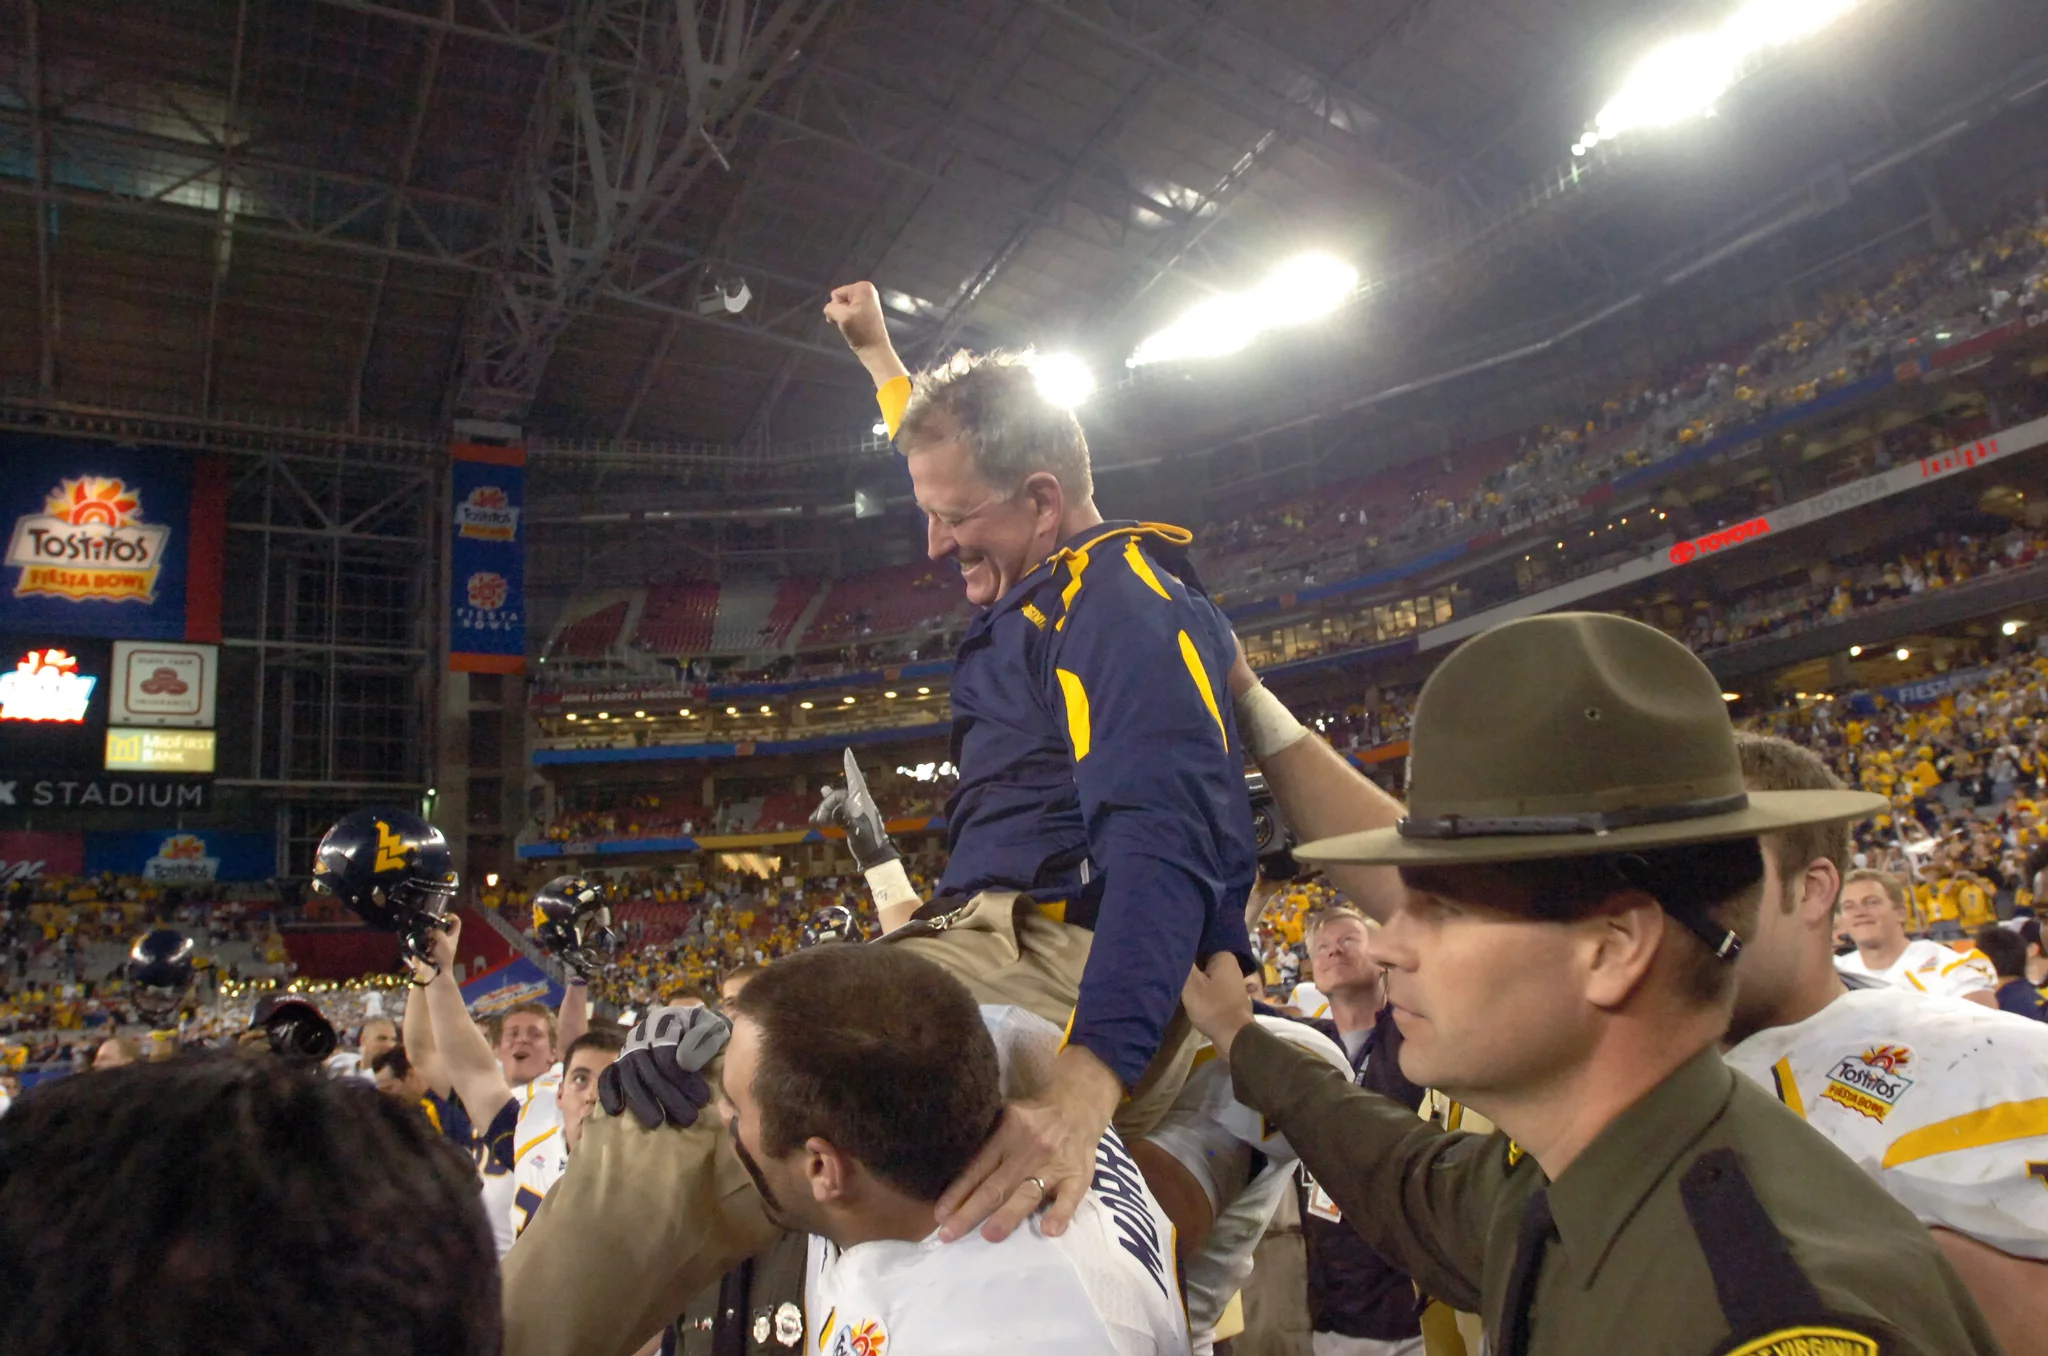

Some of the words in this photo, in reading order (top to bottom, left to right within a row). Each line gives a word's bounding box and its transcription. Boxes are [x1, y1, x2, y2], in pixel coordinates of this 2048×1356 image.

[1696, 517, 1772, 555] TOYOTA
[457, 607, 519, 621] FIESTA
[33, 781, 203, 806] STADIUM
